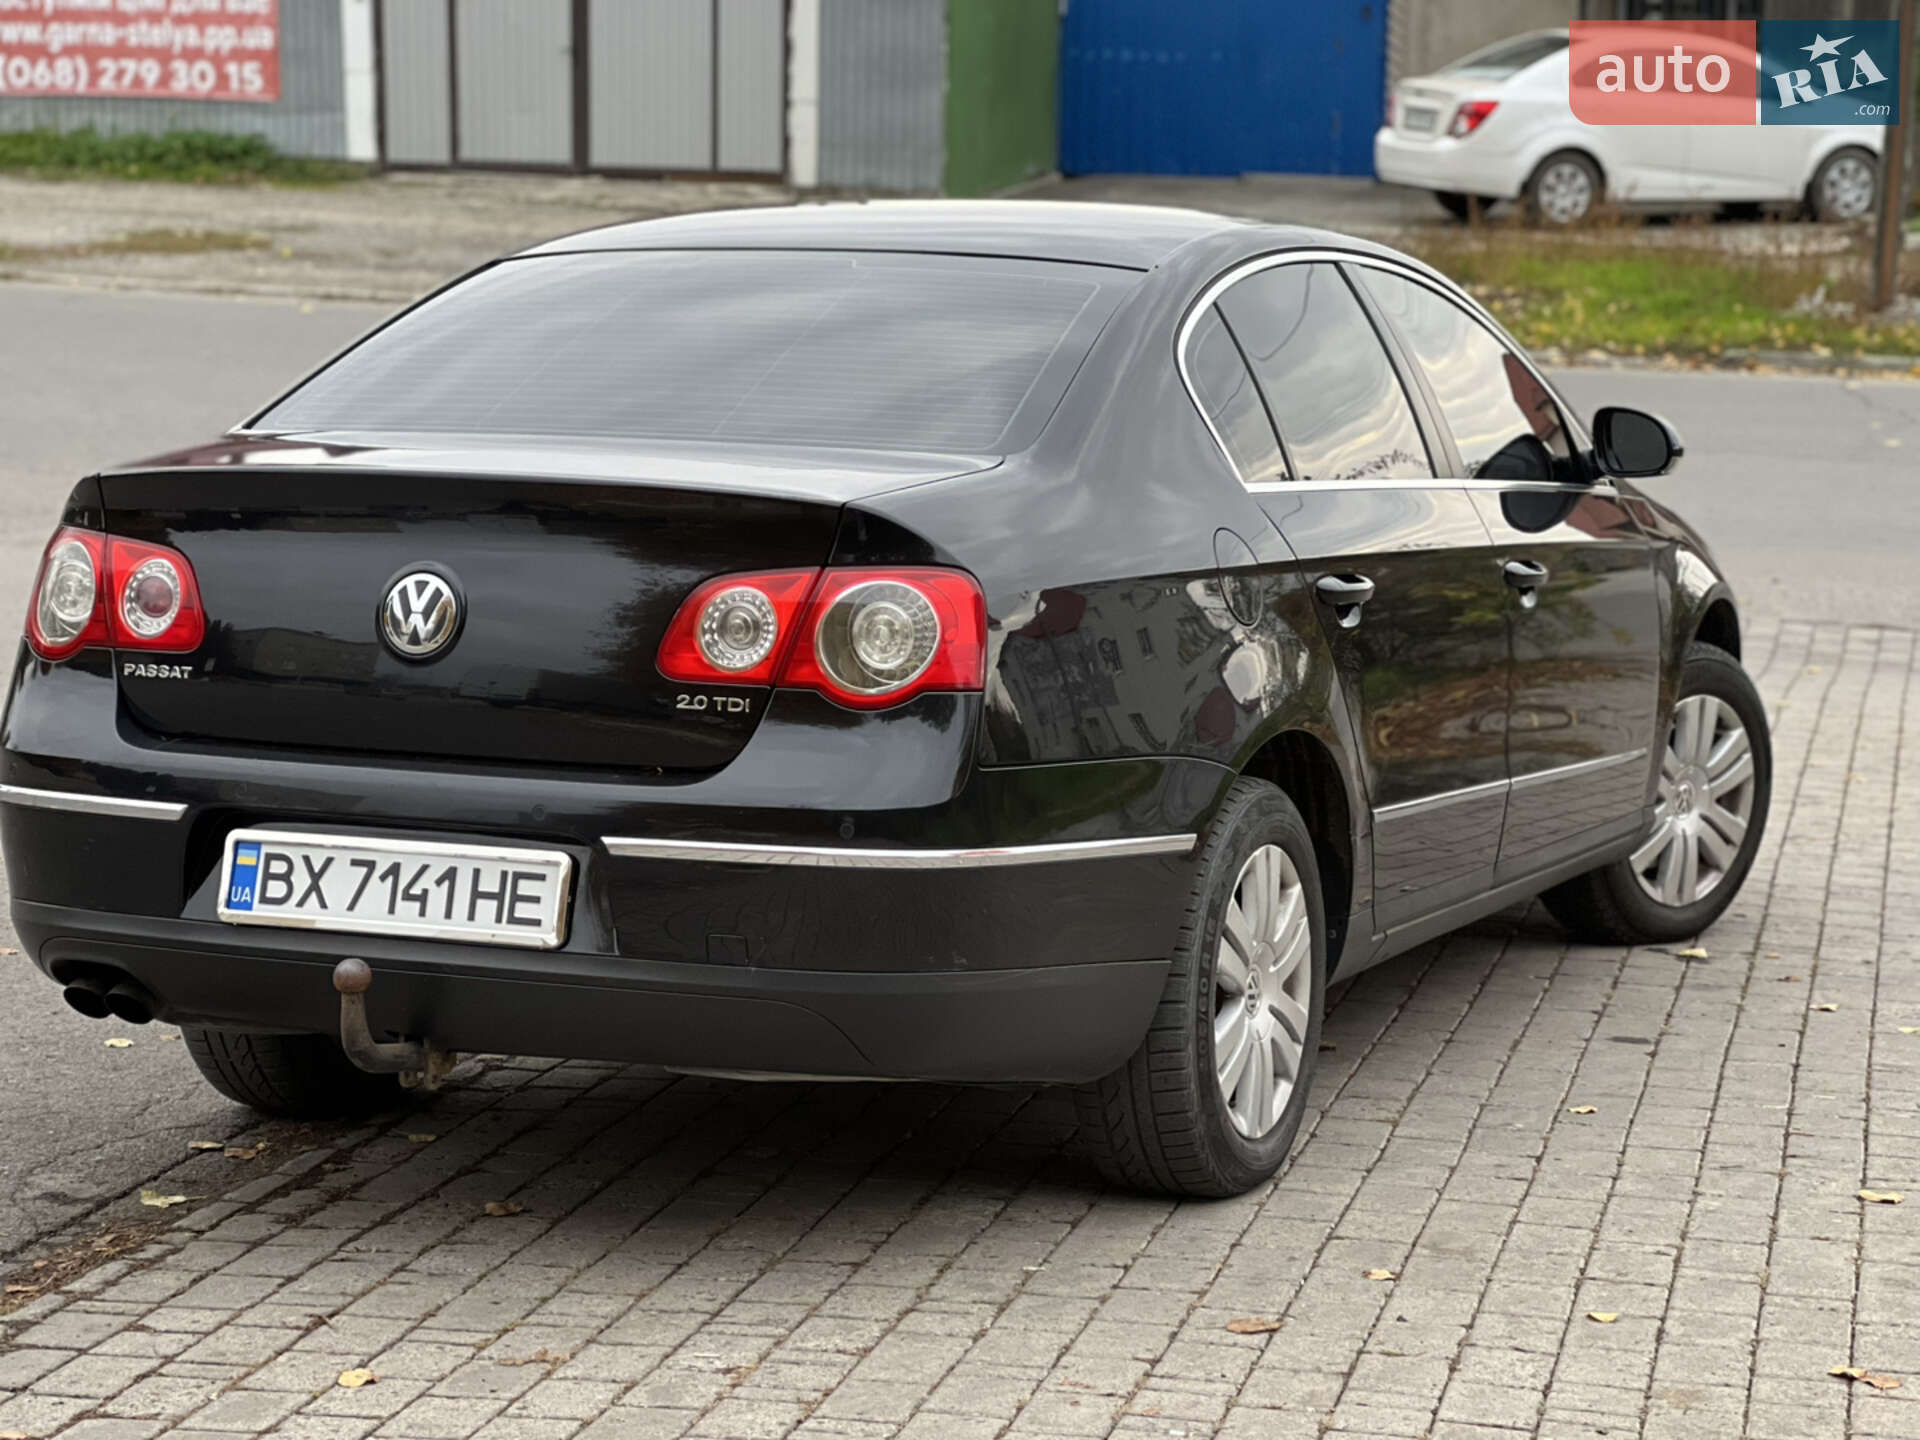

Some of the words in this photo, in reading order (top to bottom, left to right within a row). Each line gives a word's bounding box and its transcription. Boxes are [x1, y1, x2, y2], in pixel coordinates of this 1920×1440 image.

[97, 57, 161, 91] 279
[168, 59, 217, 93] 30
[224, 60, 264, 94] 15
[123, 663, 193, 679] PASSAT
[712, 696, 751, 713] TDI
[231, 886, 252, 903] UA
[258, 852, 335, 910] BX
[346, 858, 458, 920] 7141
[467, 867, 547, 927] HE
